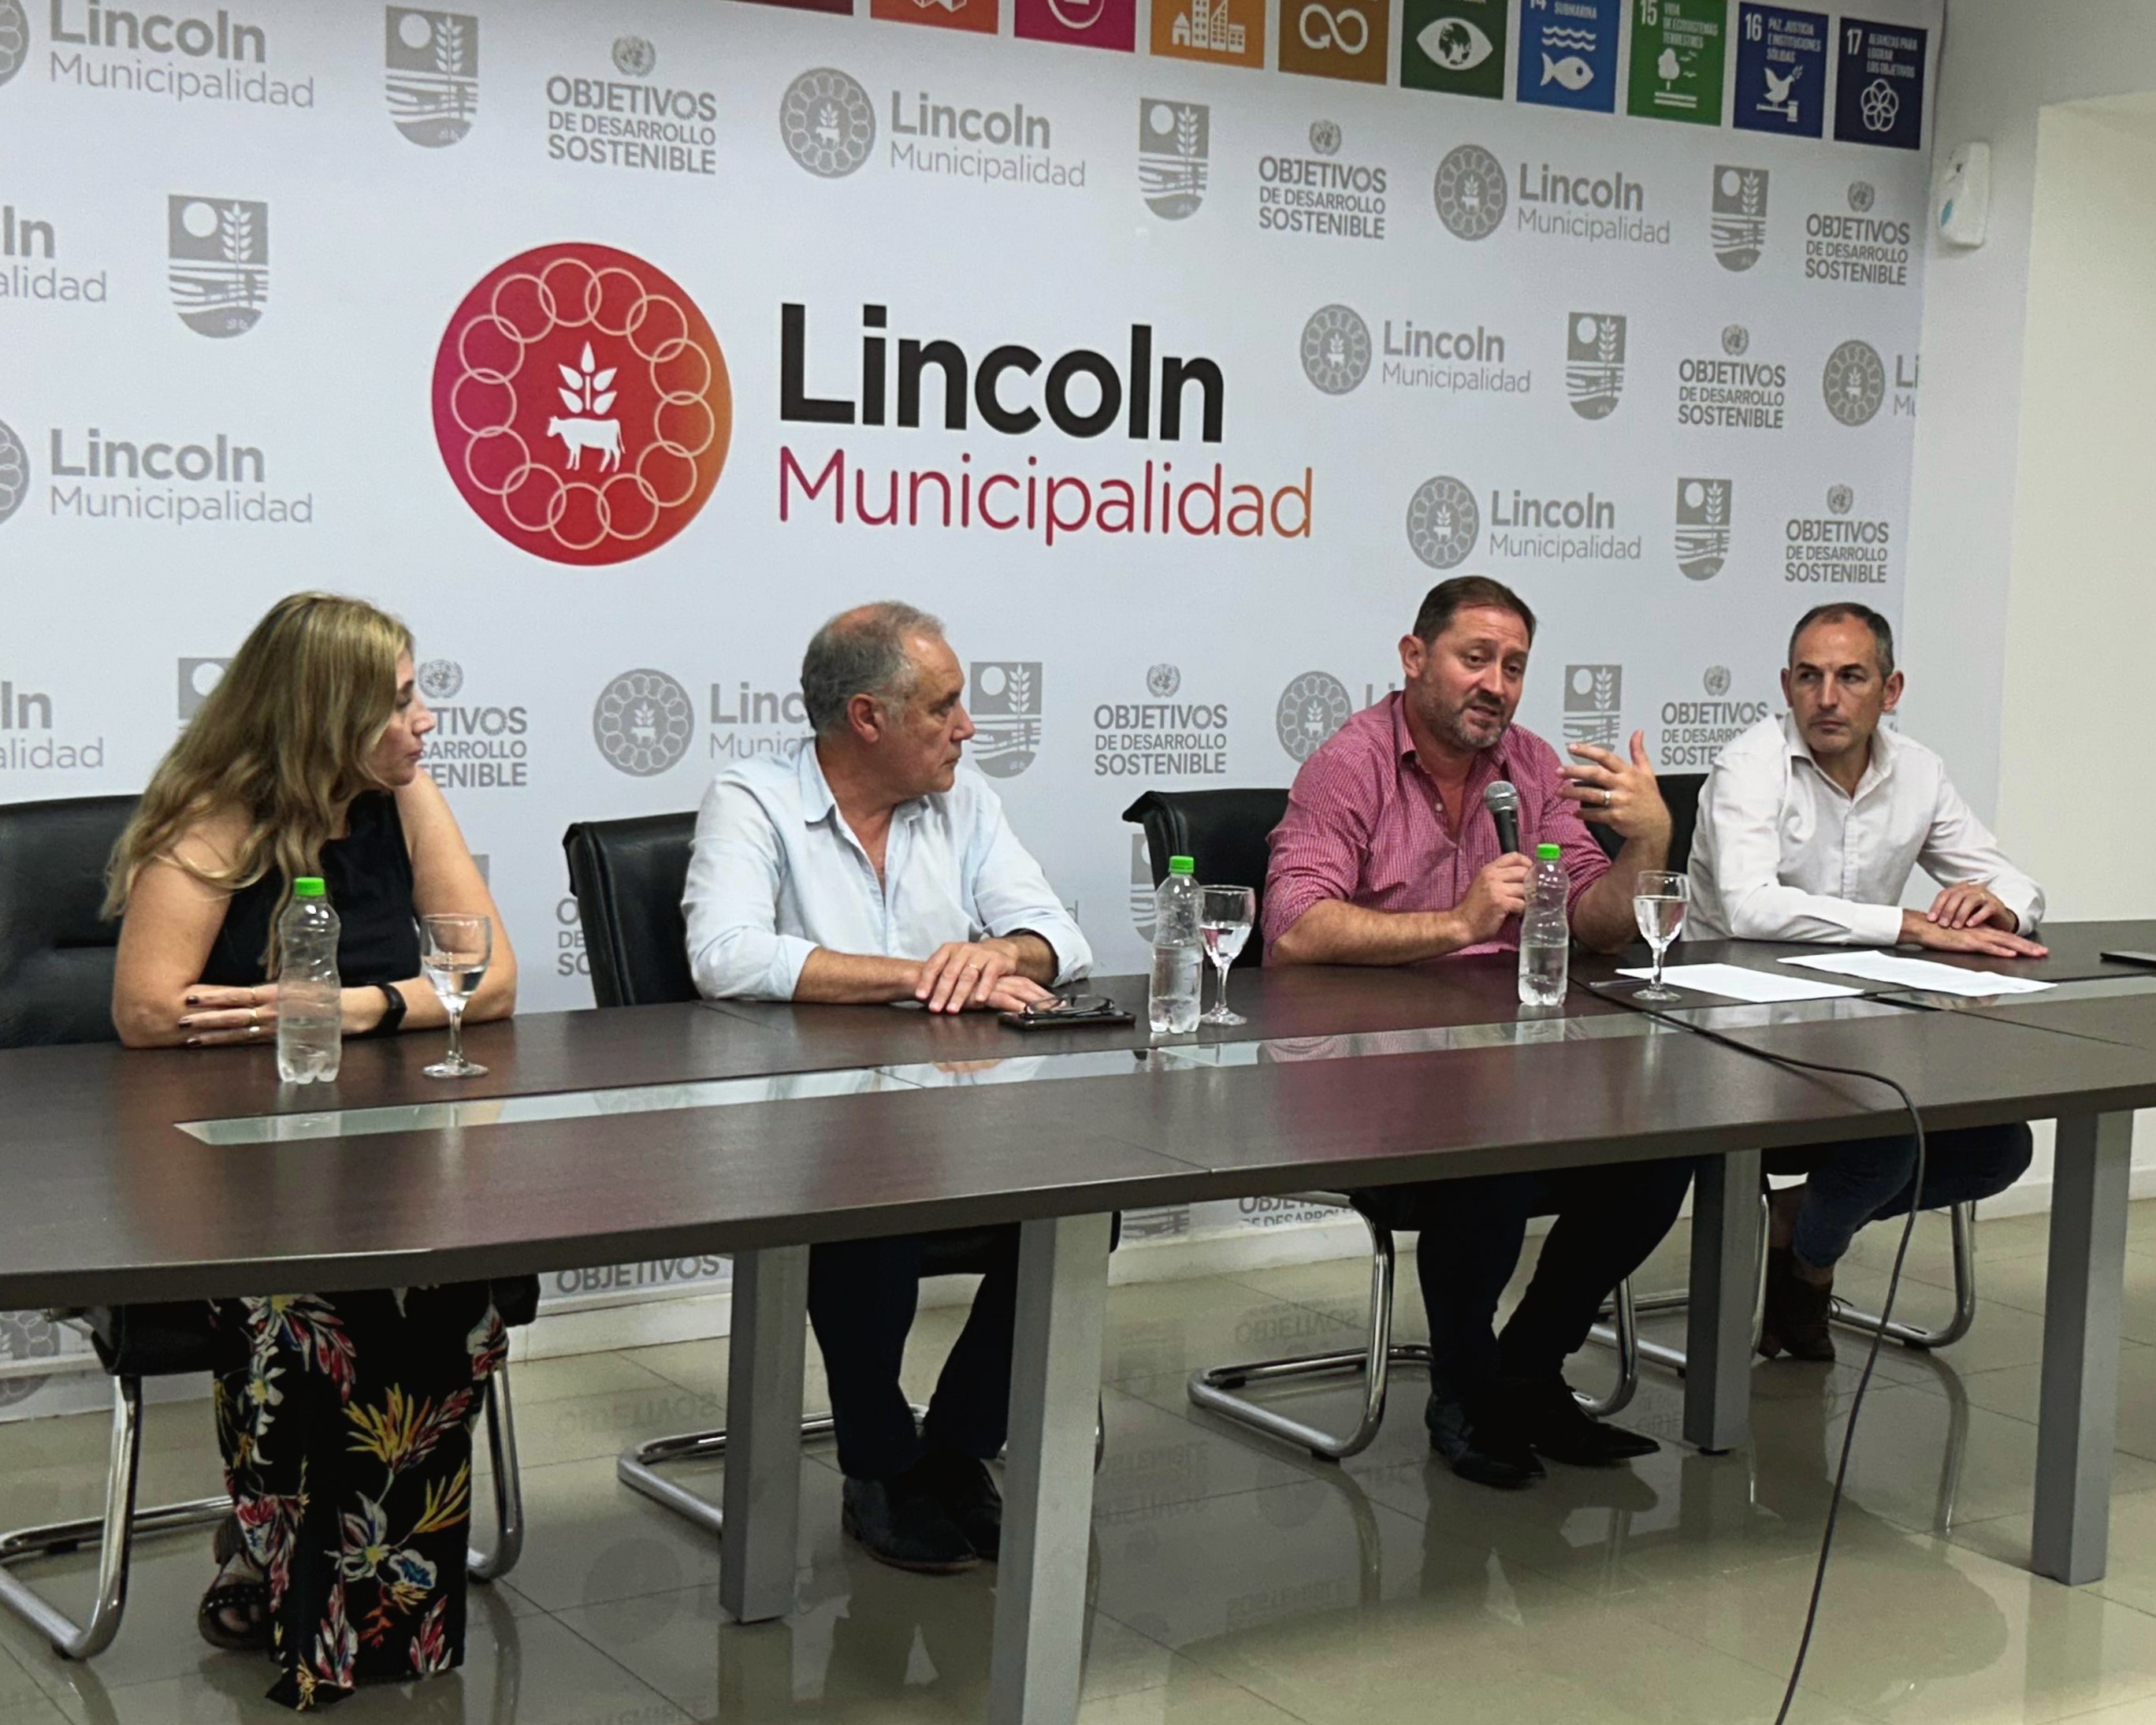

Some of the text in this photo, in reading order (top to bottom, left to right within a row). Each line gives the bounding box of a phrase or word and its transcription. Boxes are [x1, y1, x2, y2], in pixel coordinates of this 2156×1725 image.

[50, 0, 265, 63] Lincoln
[1745, 12, 1763, 42] 16
[1846, 28, 1863, 56] 17
[50, 51, 314, 107] Municipalidad
[546, 76, 716, 122] OBJETIVOS
[548, 110, 716, 146] DE DESARROLLO
[892, 91, 1050, 150] Lincoln
[548, 134, 716, 175] SOSTENIBLE
[891, 140, 1085, 187] Municipalidad
[1258, 156, 1386, 194] OBJETIVOS
[1519, 163, 1643, 211] Lincoln
[1260, 186, 1385, 214] DE DESARROLLO
[1259, 206, 1385, 240] SOSTENIBLE
[1518, 207, 1670, 244] Municipalidad
[1806, 214, 1910, 245] OBJETIVOS
[1806, 240, 1908, 263] DE DESARROLLO
[1805, 258, 1907, 286] SOSTENIBLE
[1384, 321, 1504, 362] Lincoln
[781, 303, 1224, 443] Lincoln
[1383, 362, 1530, 392] Municipalidad
[1679, 359, 1786, 388] OBJETIVOS
[1679, 386, 1784, 407] DE DESARROLLO
[1678, 403, 1783, 429] SOSTENIBLE
[51, 428, 264, 482] Lincoln
[50, 485, 312, 526] Municipalidad
[780, 446, 1311, 546] Municipalidad
[1492, 490, 1615, 529] Lincoln
[1786, 519, 1889, 544] OBJETIVOS
[1490, 533, 1641, 563] Municipalidad
[1786, 545, 1887, 561] DE DESARROLLO
[1785, 562, 1886, 583] SOSTENIBLE
[428, 706, 528, 736] TIVOS
[1094, 704, 1227, 730] OBJETIVOS
[1661, 701, 1769, 724] OBJETIVOS
[1095, 734, 1226, 750] DE DESARROLLO
[1662, 728, 1746, 743] DE DESARR
[1095, 753, 1226, 776] SOSTENIBLE
[1660, 745, 1723, 765] SOSTE
[556, 1257, 719, 1293] OBJETIVOS
